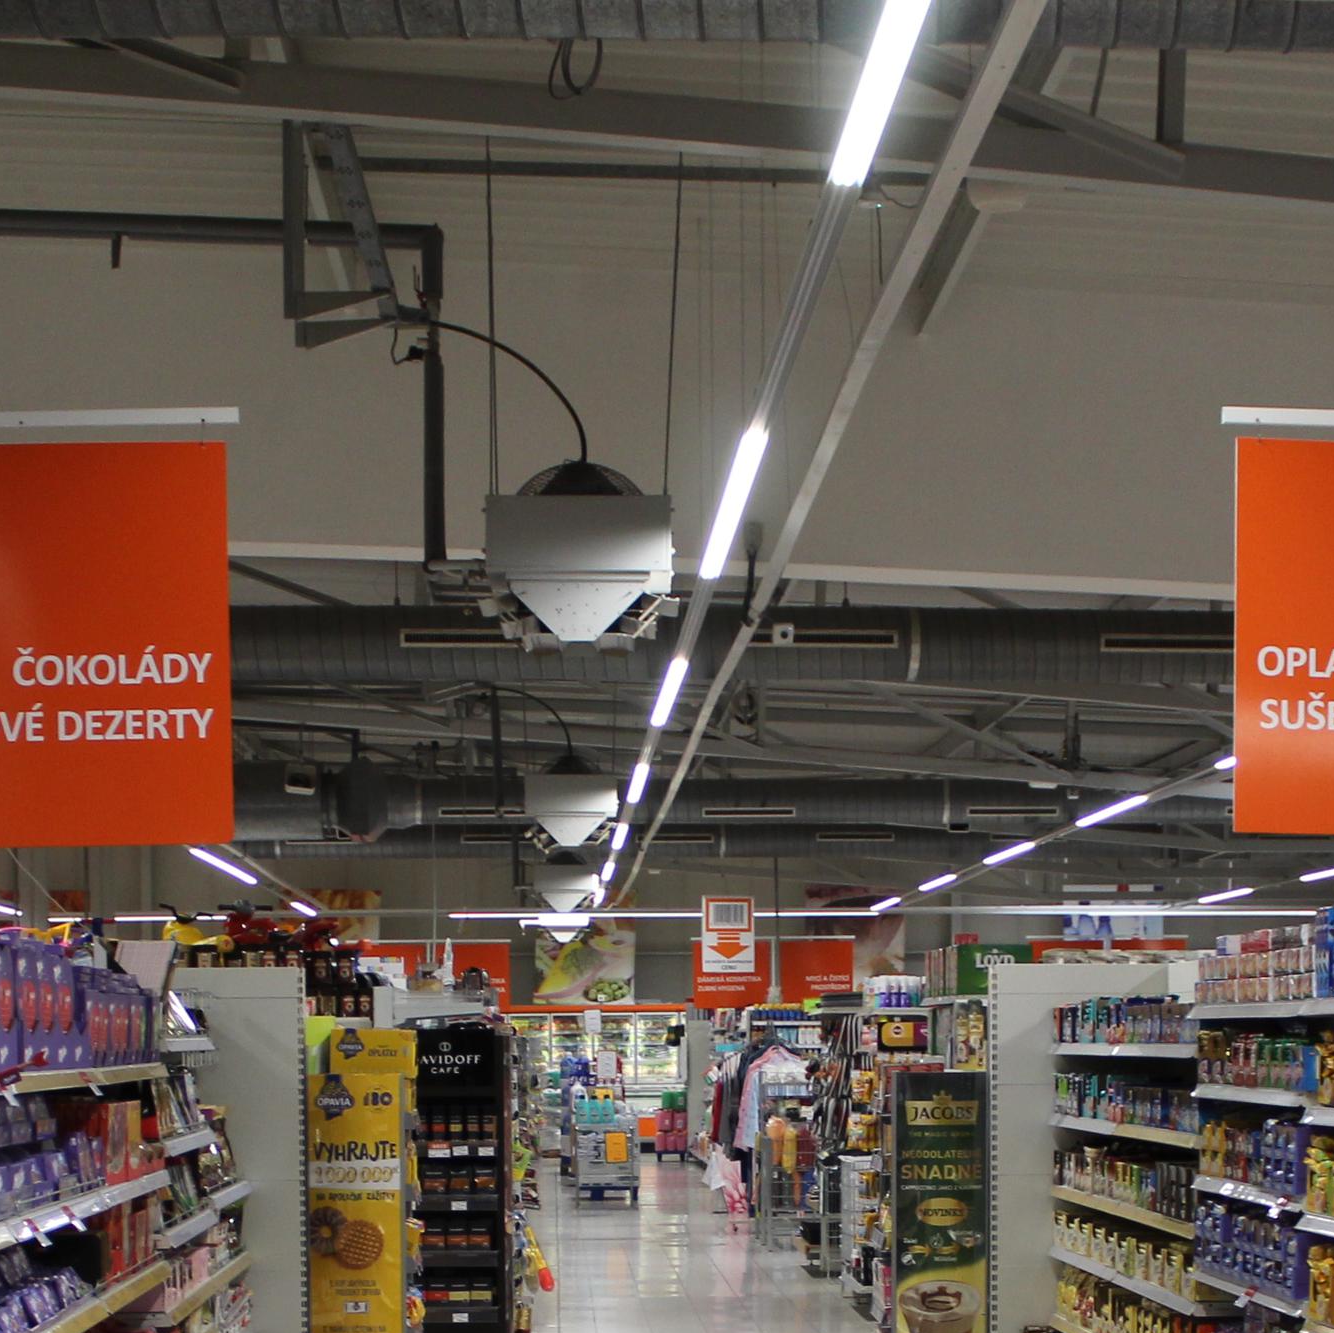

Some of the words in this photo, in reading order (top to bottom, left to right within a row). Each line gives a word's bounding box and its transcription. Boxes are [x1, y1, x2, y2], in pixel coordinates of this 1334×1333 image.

[14, 646, 211, 686] ČOKOLÁDY
[58, 709, 213, 740] DEZERTY
[975, 951, 1016, 969] LOYD
[419, 1054, 482, 1065] AVIDOFF
[317, 1096, 352, 1107] OPAVIA
[910, 1106, 975, 1122] JACOBS
[313, 1140, 397, 1163] VYHRAJTE
